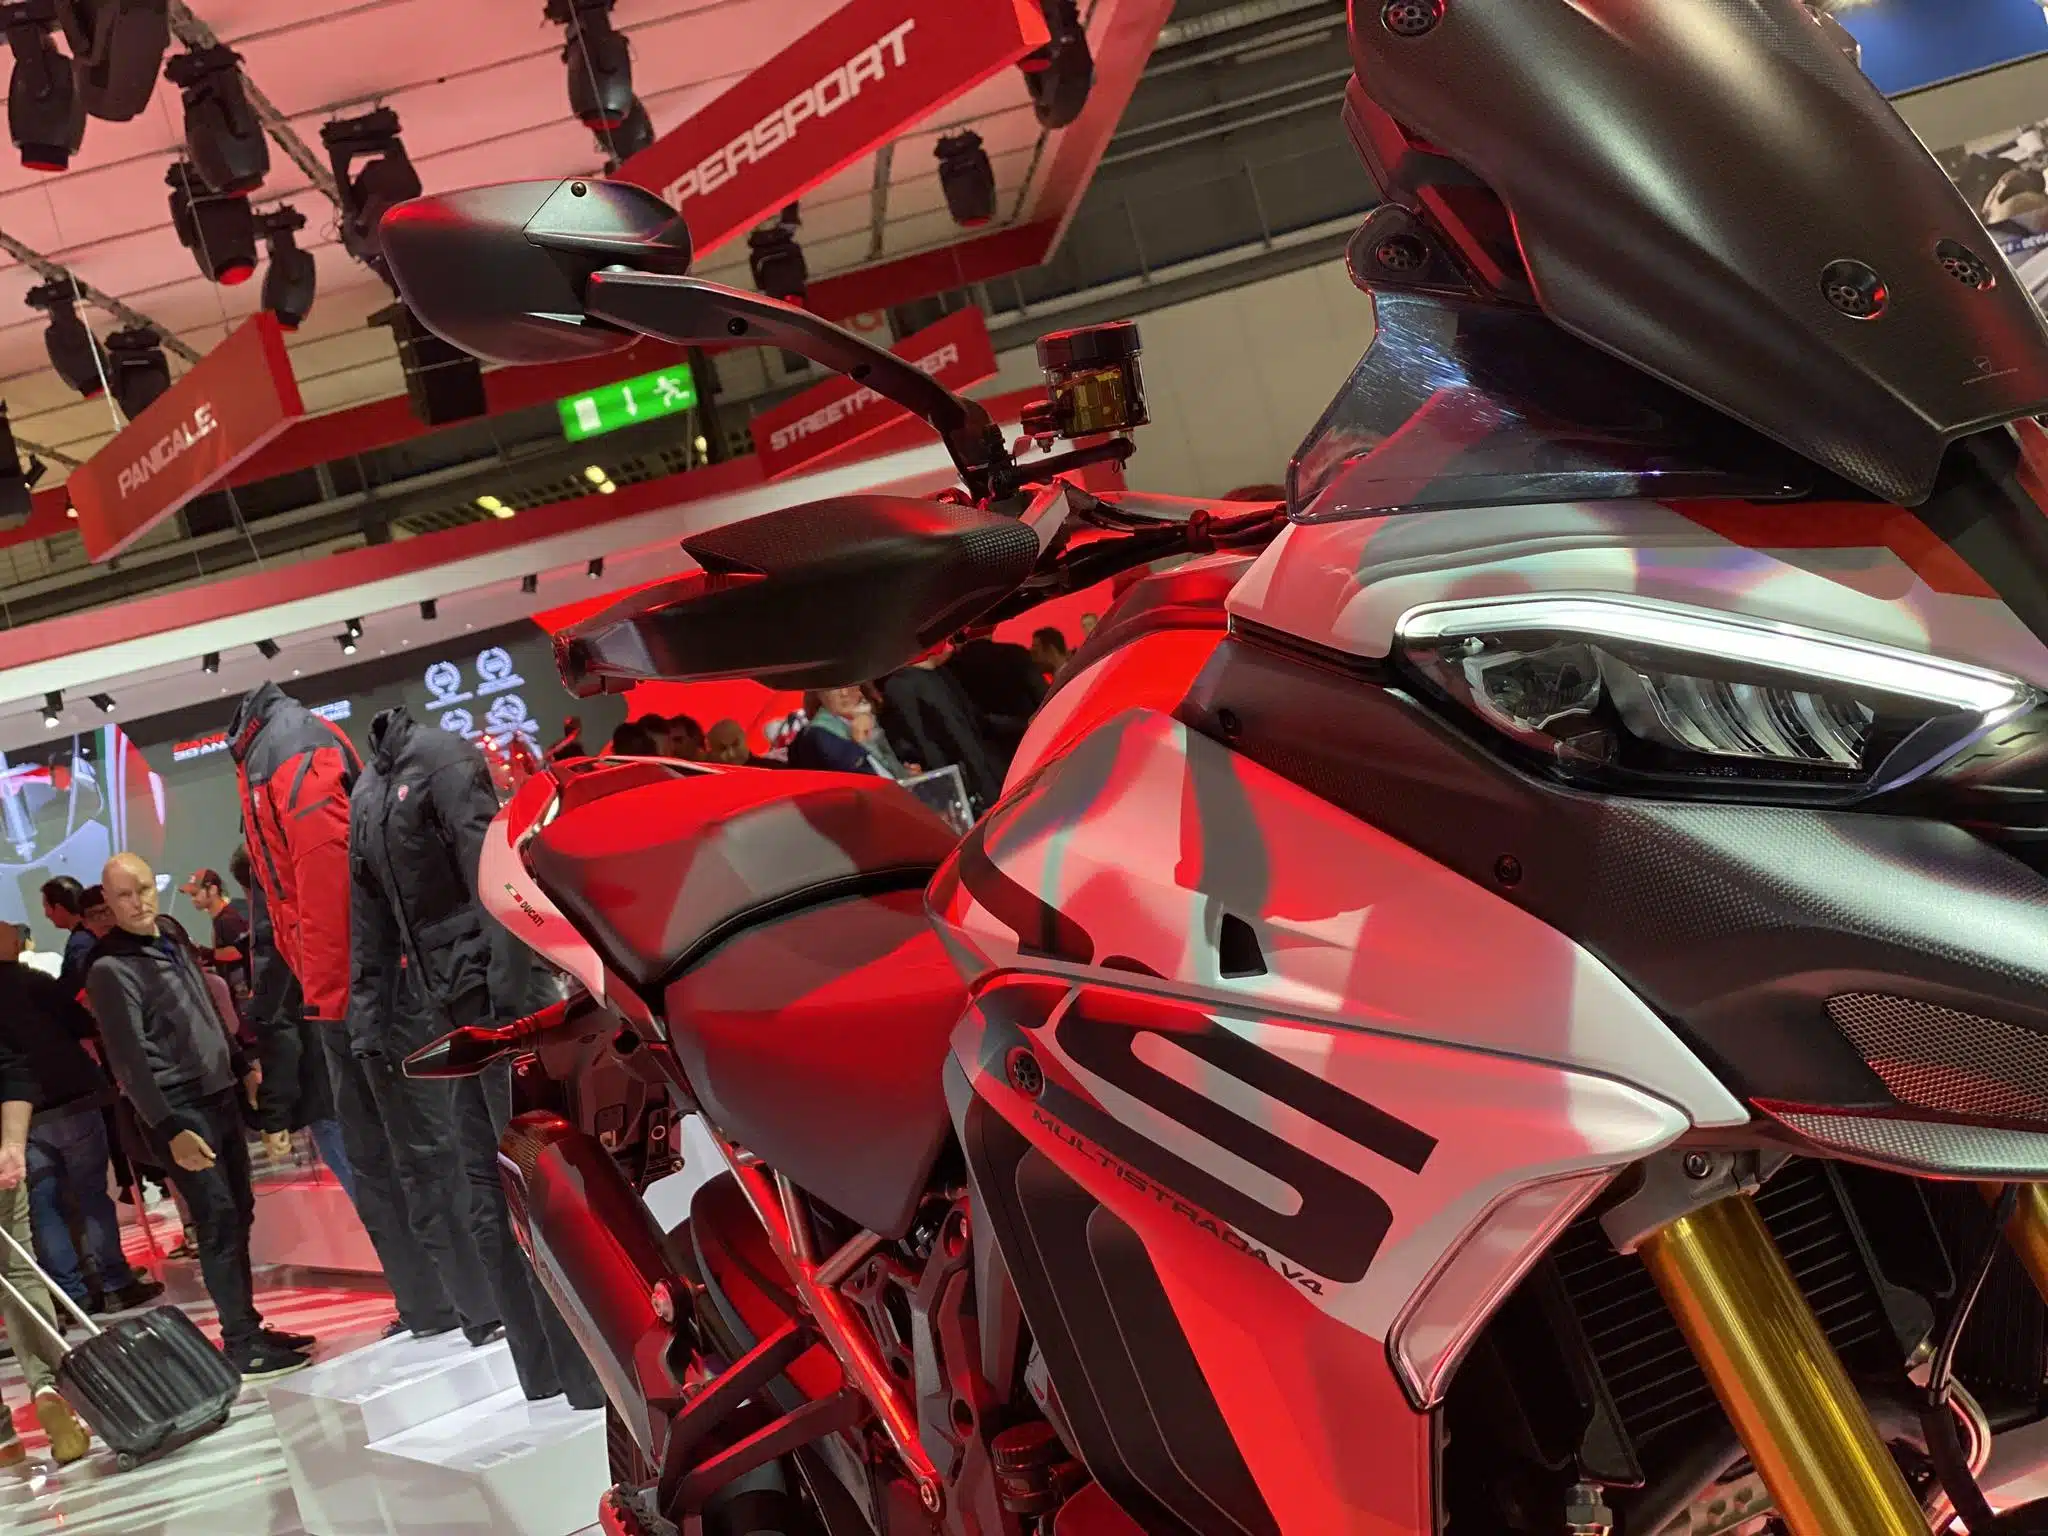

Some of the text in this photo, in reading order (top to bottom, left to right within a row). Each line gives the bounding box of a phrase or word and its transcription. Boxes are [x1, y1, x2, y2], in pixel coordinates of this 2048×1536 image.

[661, 17, 915, 212] PERSPORT
[117, 401, 218, 500] PANIGALE
[520, 899, 545, 928] DUCATI
[1031, 1108, 1324, 1297] MULTISTRADA V4
